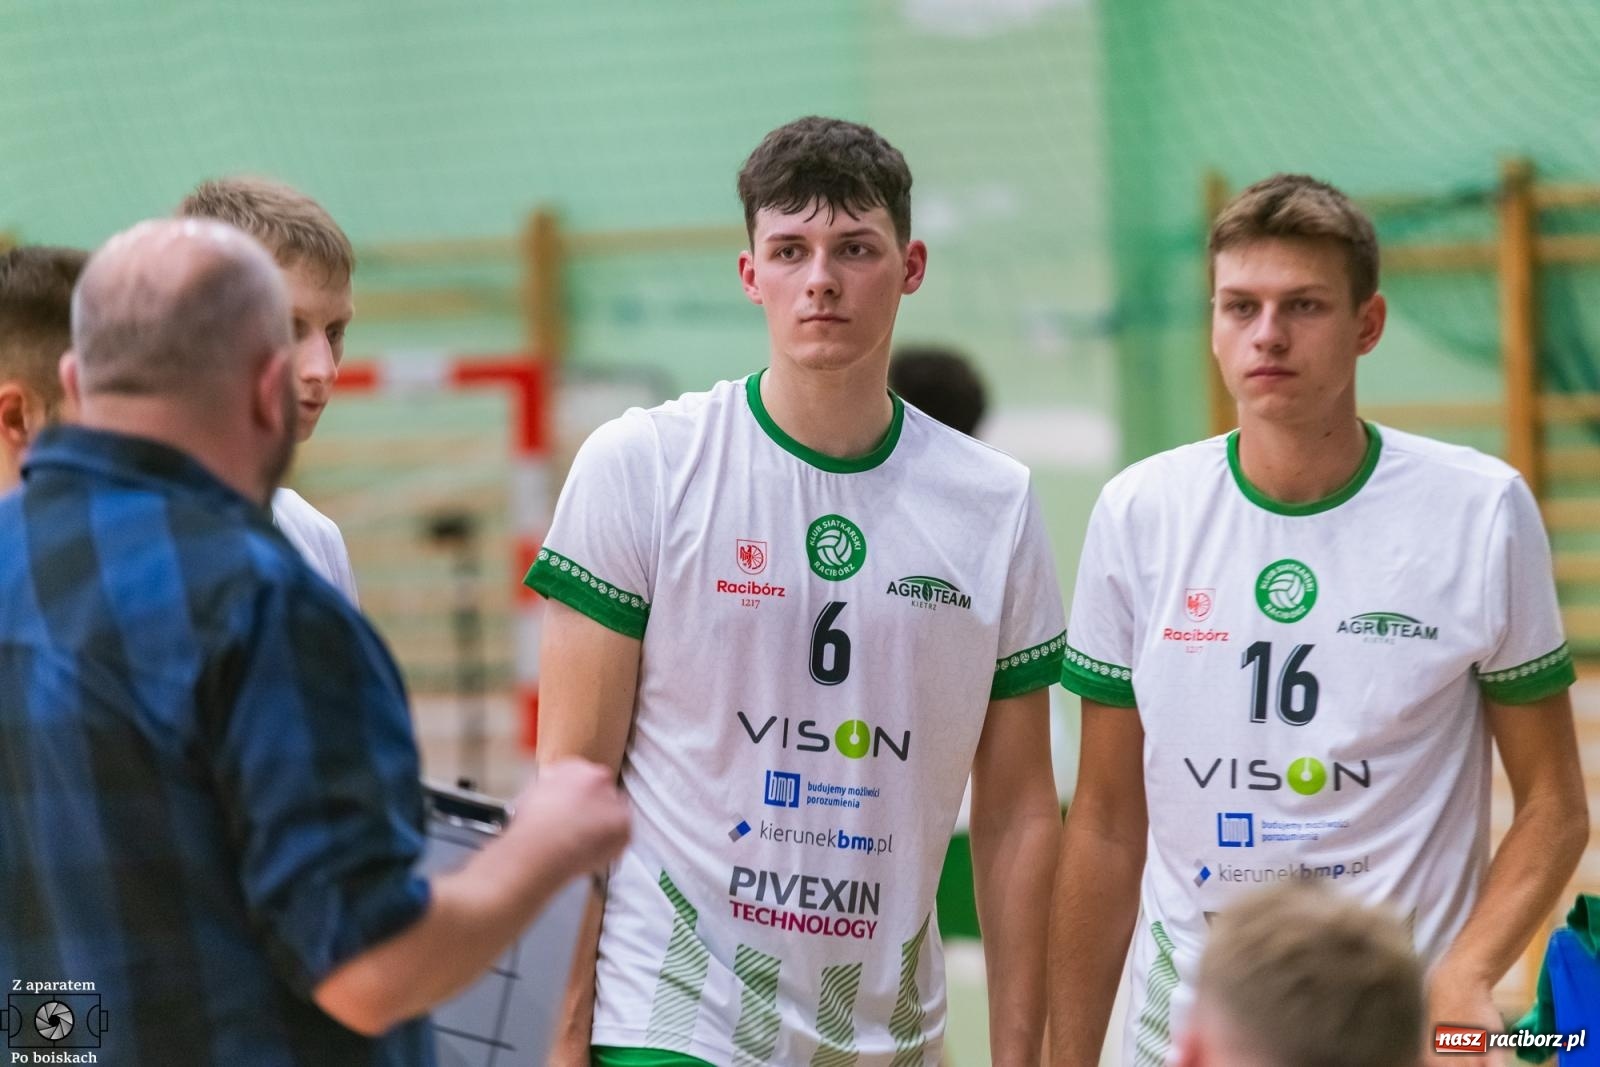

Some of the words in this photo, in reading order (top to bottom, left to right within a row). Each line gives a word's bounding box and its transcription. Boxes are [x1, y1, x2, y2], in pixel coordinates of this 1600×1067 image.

[809, 525, 822, 546] KLUB
[822, 520, 861, 550] SIATKARSKI
[814, 561, 855, 576] RACIBÓRZ
[716, 580, 785, 597] Racibórz
[741, 598, 761, 609] 1217
[911, 600, 937, 611] KIETRZ
[808, 601, 851, 686] 6
[1163, 628, 1229, 641] Racibórz
[1240, 640, 1320, 727] 16
[737, 711, 911, 761] VISON
[807, 781, 846, 796] budujemy
[1184, 757, 1371, 796] VISON
[807, 796, 860, 808] porozumienia
[760, 820, 892, 855] kierunekbmp.pl
[729, 865, 881, 916] PIVEXIN
[729, 900, 878, 940] TECHNOLOGY
